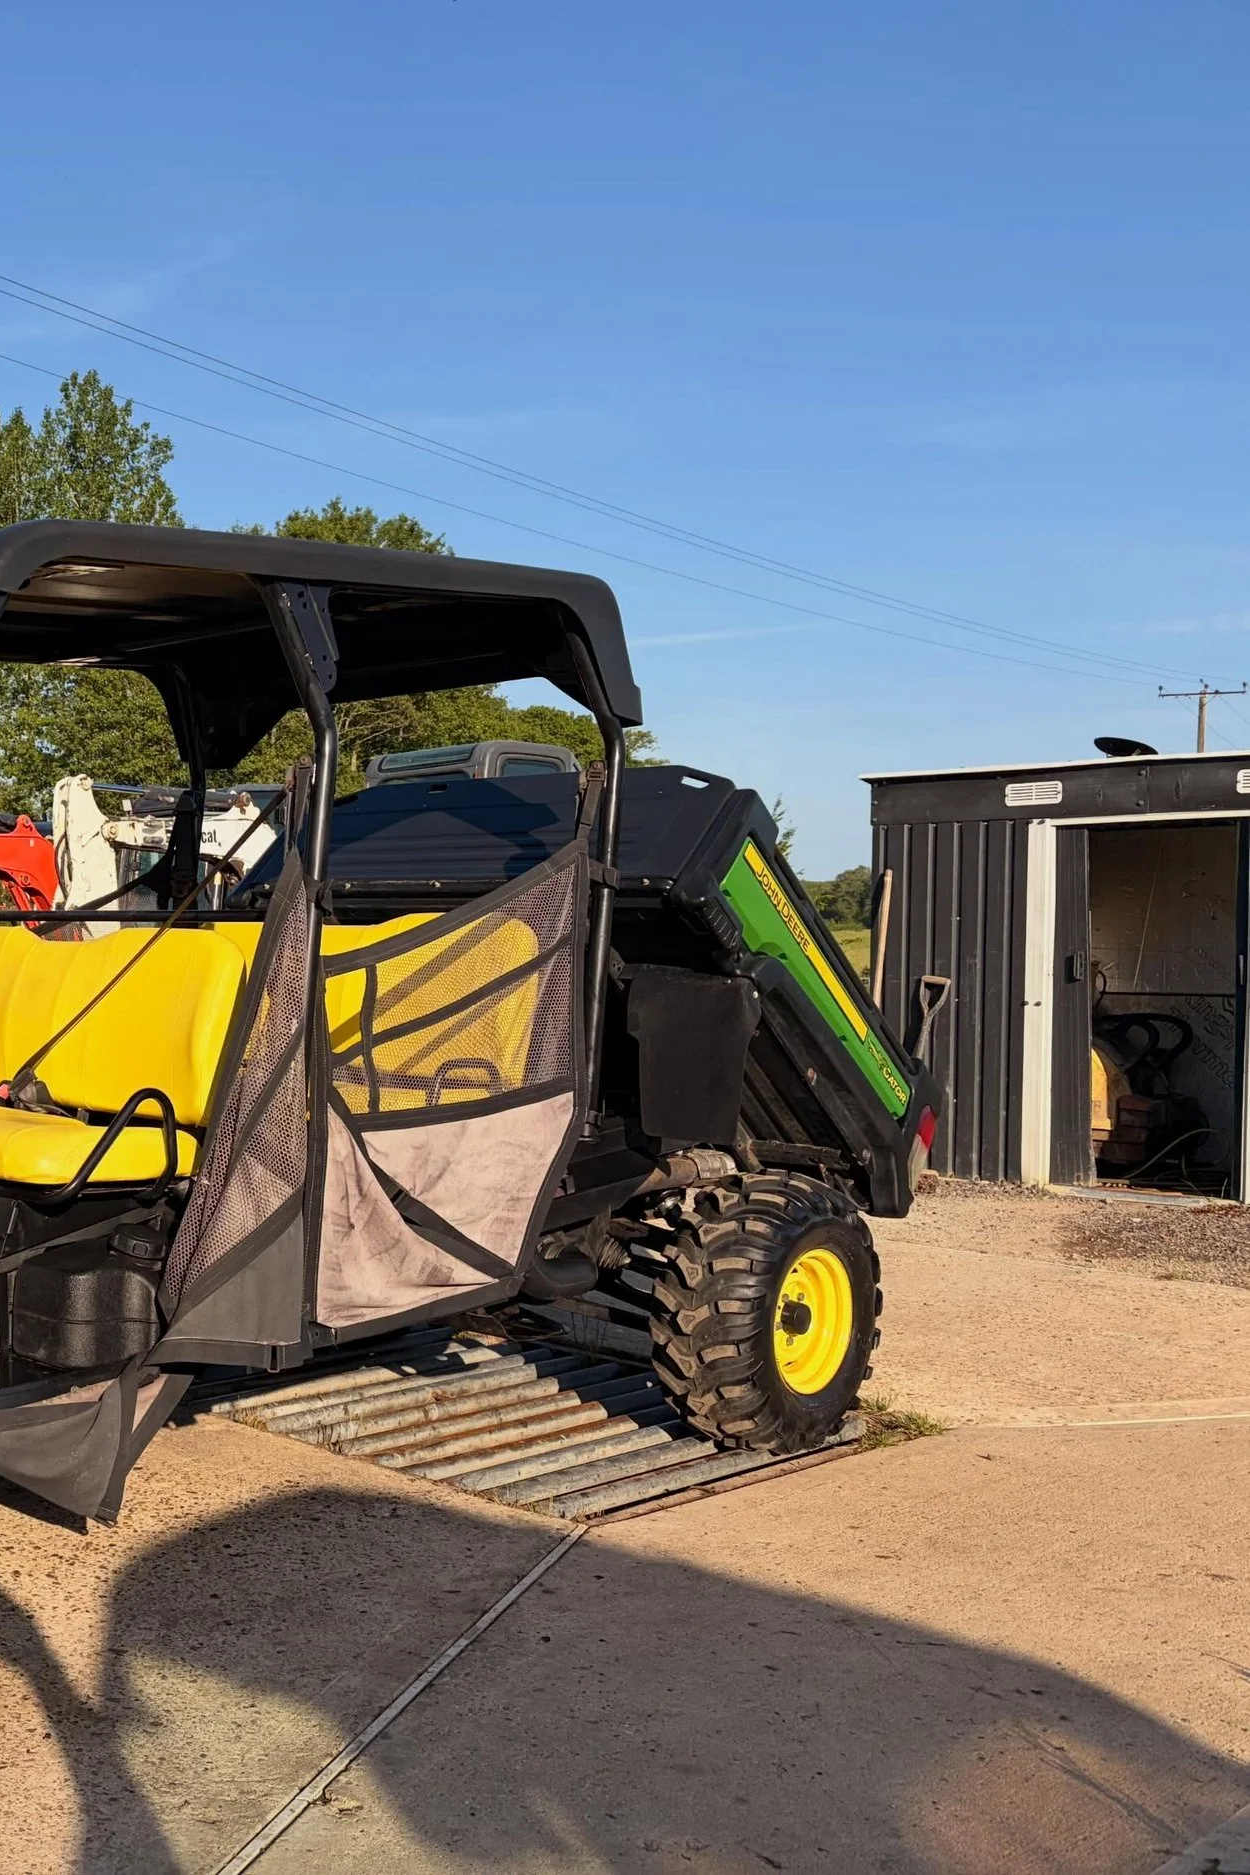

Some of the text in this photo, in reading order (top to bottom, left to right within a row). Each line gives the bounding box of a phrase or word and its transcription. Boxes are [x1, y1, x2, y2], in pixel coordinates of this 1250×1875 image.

[756, 867, 810, 952] JOHN DEERE
[883, 1067, 907, 1104] GATOR
